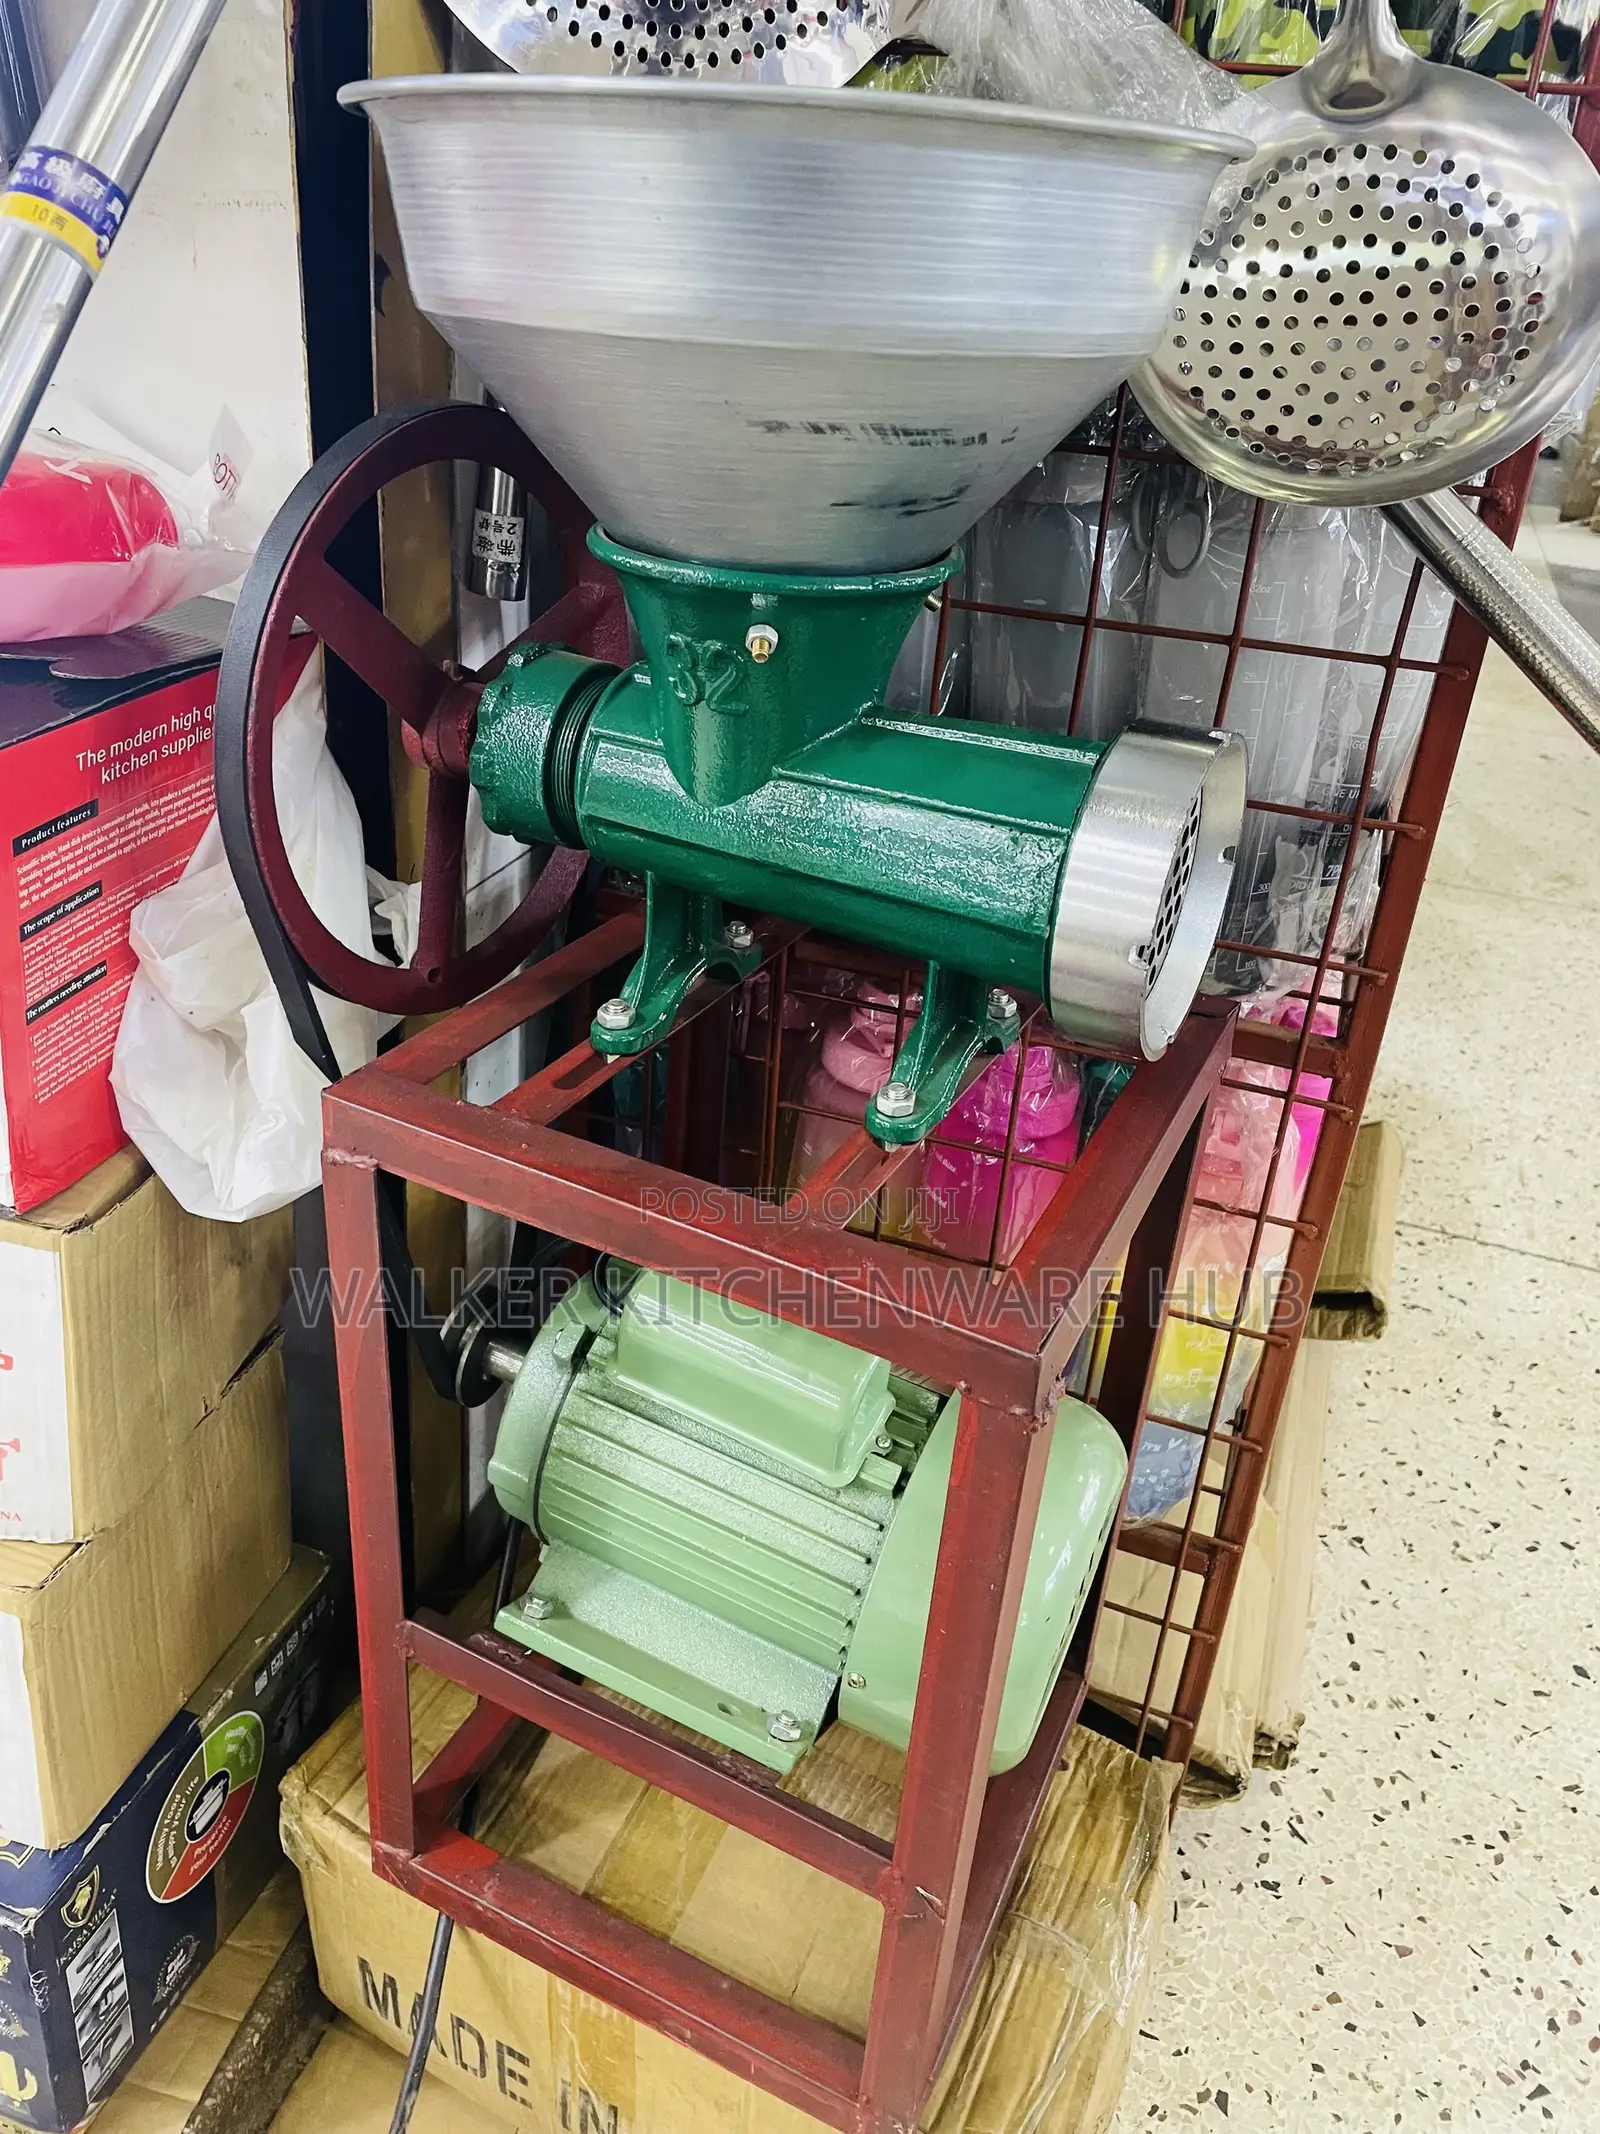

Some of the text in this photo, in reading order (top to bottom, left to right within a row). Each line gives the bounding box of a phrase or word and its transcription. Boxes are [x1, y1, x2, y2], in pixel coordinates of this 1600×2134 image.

[76, 749, 106, 771] The
[110, 723, 167, 758] modern
[171, 706, 201, 732] high
[101, 726, 215, 785] kitchen supplie
[21, 808, 92, 849] Product features
[23, 886, 100, 935] The scope of application
[27, 964, 107, 1020] The matters needing attention
[164, 1793, 181, 1825] food
[171, 1798, 187, 1828] your
[186, 1775, 200, 1797] life
[560, 2076, 618, 2134] IN
